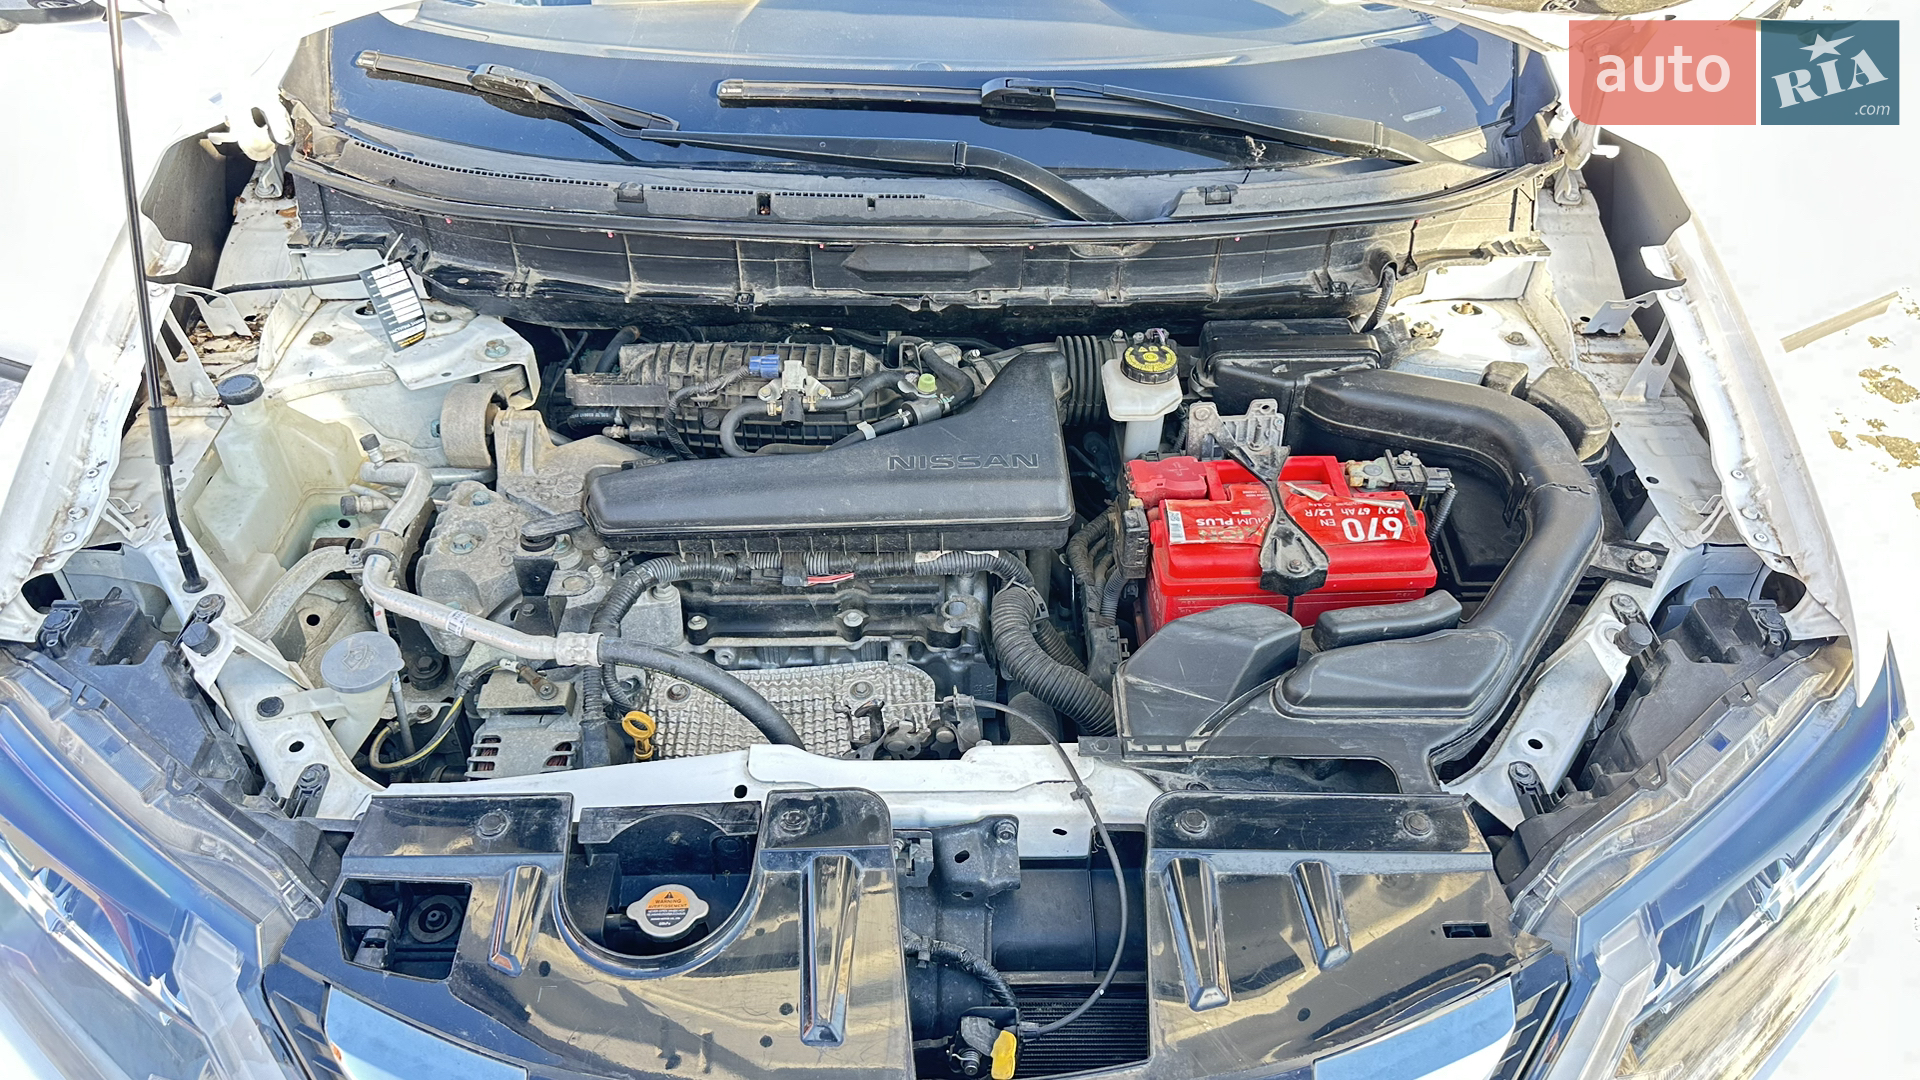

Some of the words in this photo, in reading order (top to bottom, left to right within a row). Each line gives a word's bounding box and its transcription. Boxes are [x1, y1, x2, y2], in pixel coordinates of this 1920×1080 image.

[887, 453, 1039, 471] NISSAN
[1340, 507, 1355, 516] Ah
[1357, 507, 1371, 515] 67
[1195, 518, 1234, 527] PLUS
[1319, 518, 1337, 527] EN
[1341, 516, 1403, 543] 670
